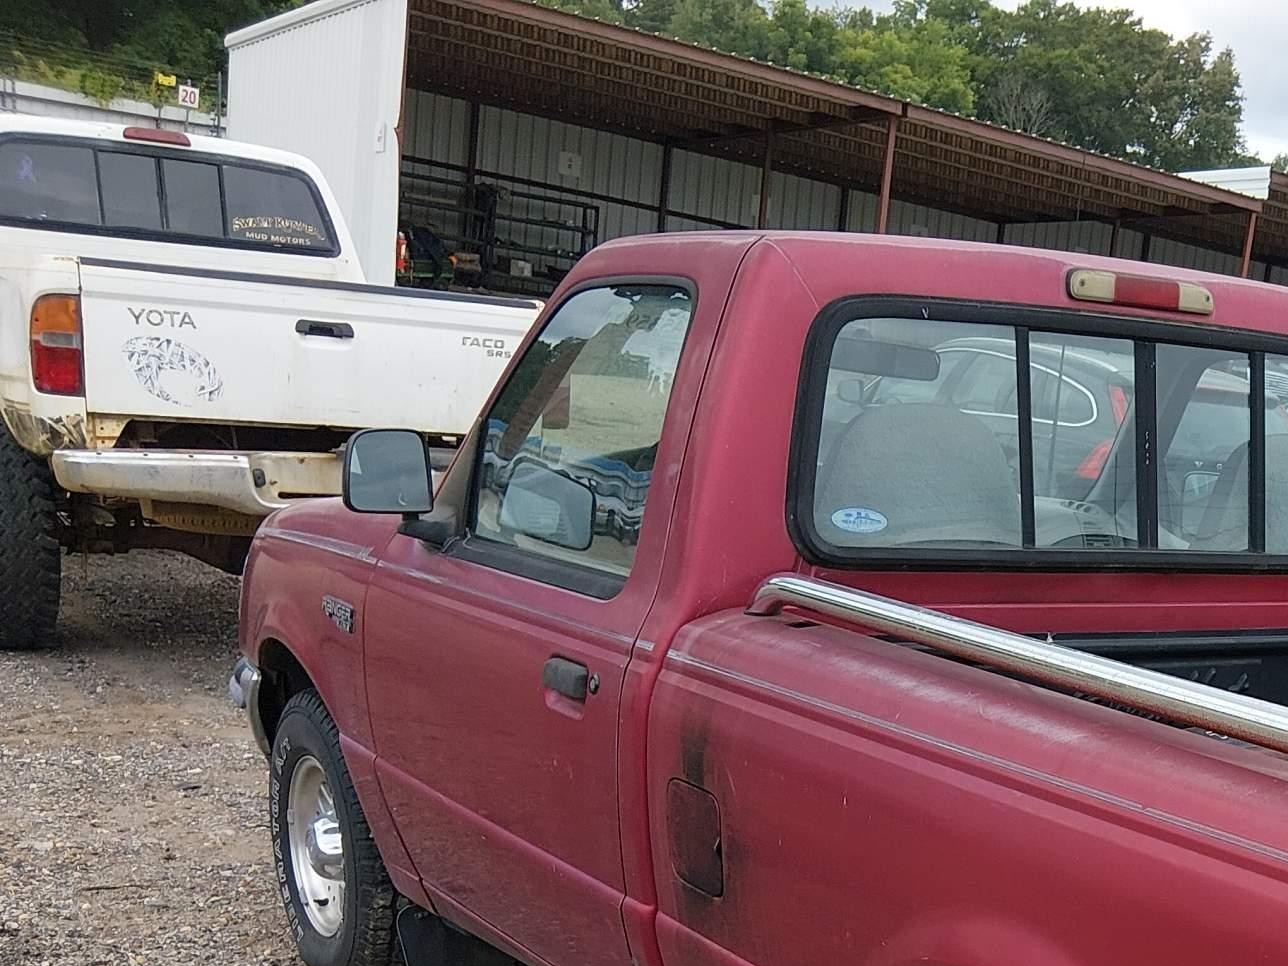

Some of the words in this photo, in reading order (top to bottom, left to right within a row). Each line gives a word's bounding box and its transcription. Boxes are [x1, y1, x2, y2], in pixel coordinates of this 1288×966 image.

[182, 89, 196, 104] 20
[245, 231, 268, 240] MUD
[271, 235, 311, 245] MOTORS
[127, 307, 197, 329] YOTA
